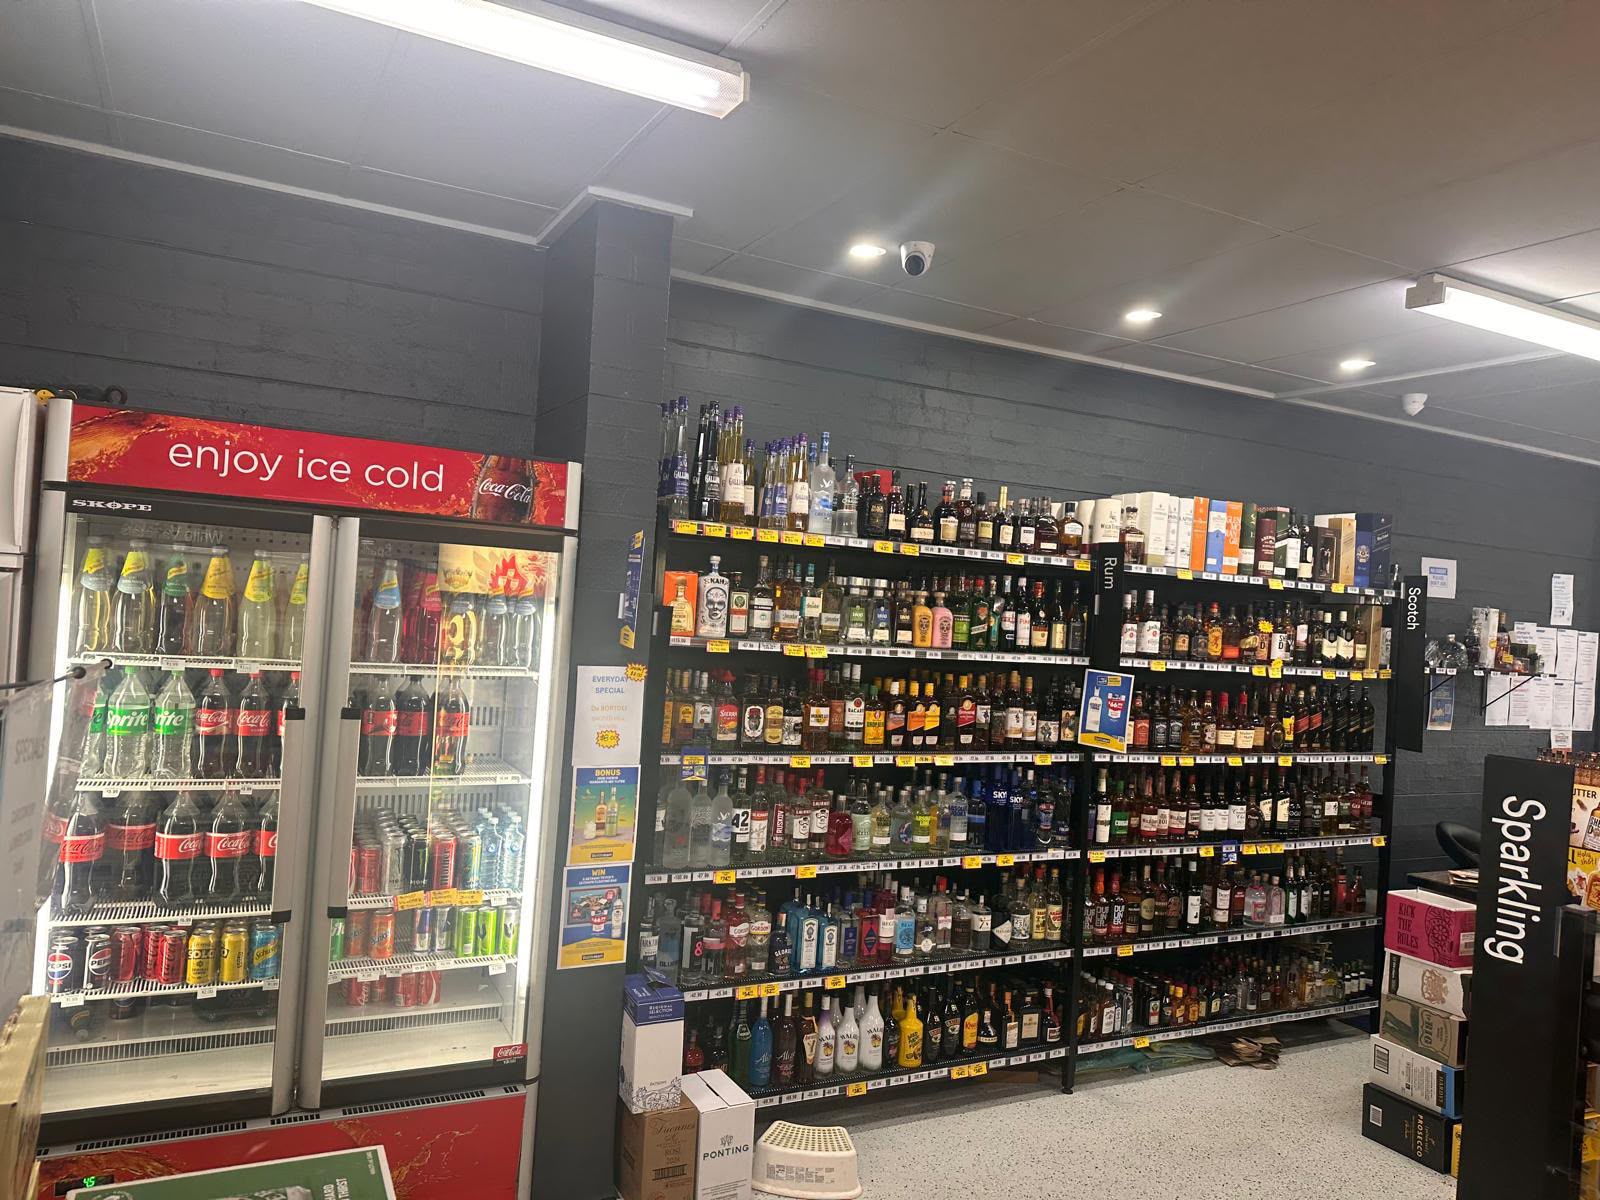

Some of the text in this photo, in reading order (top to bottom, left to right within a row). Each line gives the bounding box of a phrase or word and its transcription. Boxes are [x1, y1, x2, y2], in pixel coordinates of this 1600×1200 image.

[169, 441, 443, 492] enjoy ice cold
[72, 499, 152, 512] SKOPE
[1104, 557, 1118, 589] Rum
[1407, 587, 1421, 630] Scotch
[592, 675, 628, 683] EVERYDAY
[107, 710, 148, 731] Sprite
[595, 768, 621, 777] BONUS
[732, 810, 750, 829] 42
[591, 868, 606, 877] WIN
[1483, 795, 1547, 965] Sparkling
[750, 924, 770, 932] GORDON
[187, 949, 217, 959] SOLO
[1416, 1113, 1424, 1157] PROSECCO
[702, 1144, 750, 1161] PONTING
